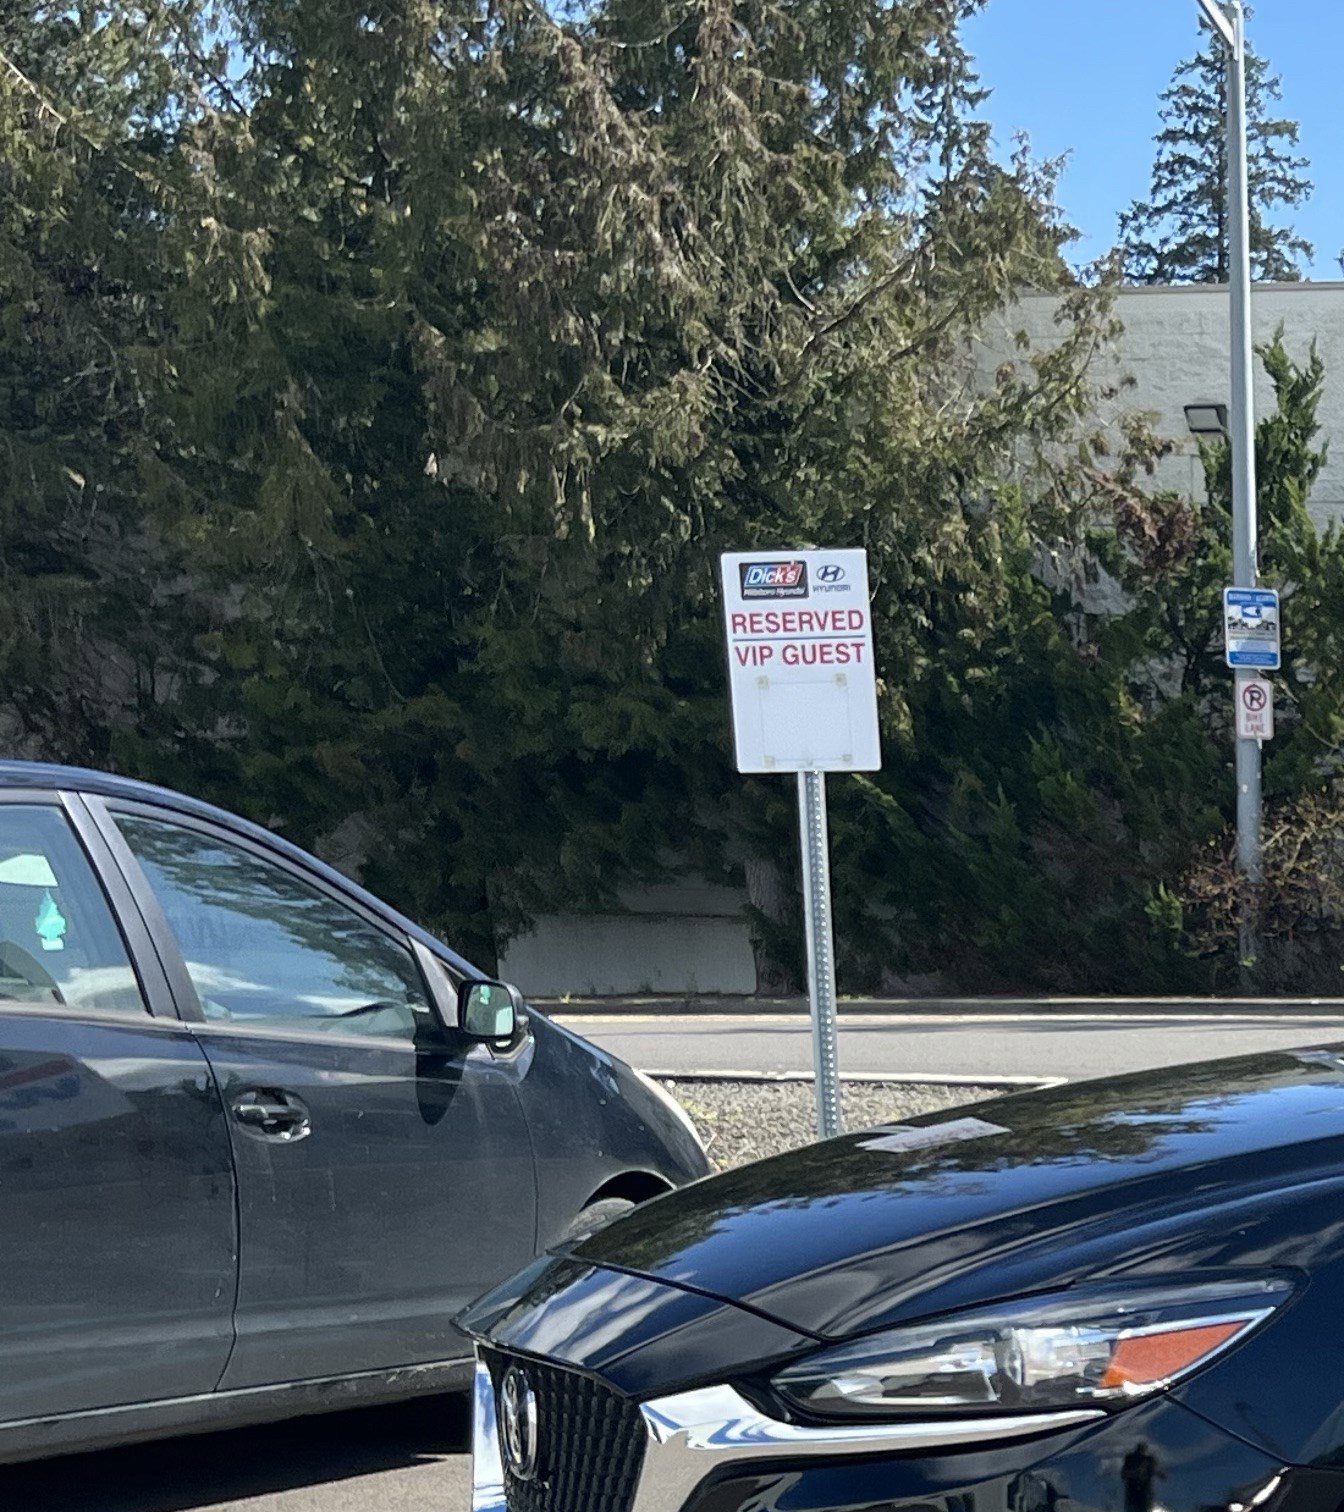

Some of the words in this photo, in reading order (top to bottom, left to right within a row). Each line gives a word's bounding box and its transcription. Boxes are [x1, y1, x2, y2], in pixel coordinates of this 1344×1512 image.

[731, 609, 864, 634] RESERVED
[735, 645, 773, 667] VIP
[782, 642, 865, 665] GUEST
